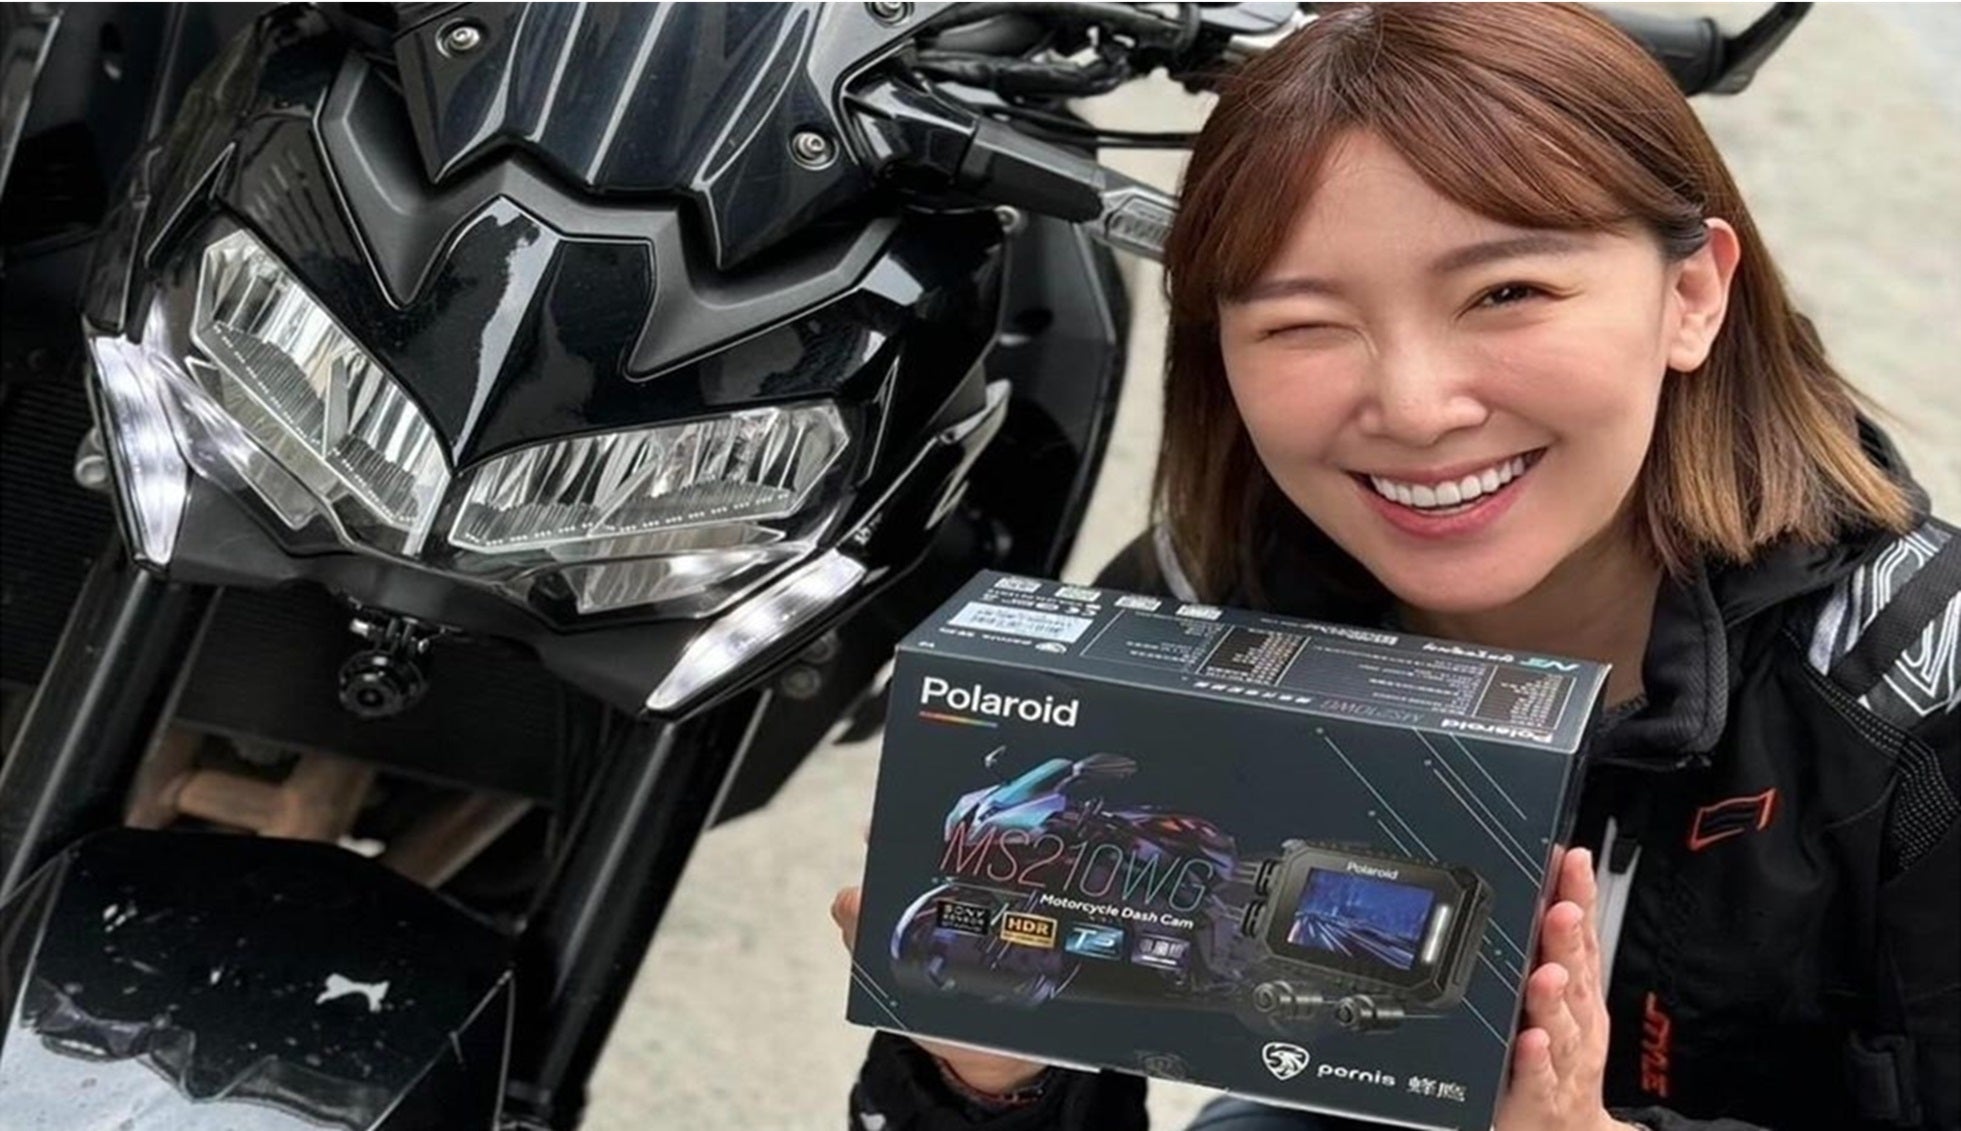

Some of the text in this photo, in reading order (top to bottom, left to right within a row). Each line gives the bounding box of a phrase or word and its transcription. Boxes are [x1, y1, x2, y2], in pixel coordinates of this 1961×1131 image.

[921, 676, 1079, 727] Polaroid
[1441, 719, 1553, 743] Polaroid
[940, 821, 1214, 912] MS210WG
[1346, 861, 1399, 880] Polaroid
[1008, 917, 1050, 935] HDR
[1040, 894, 1194, 929] Motorcycle Dash Cam
